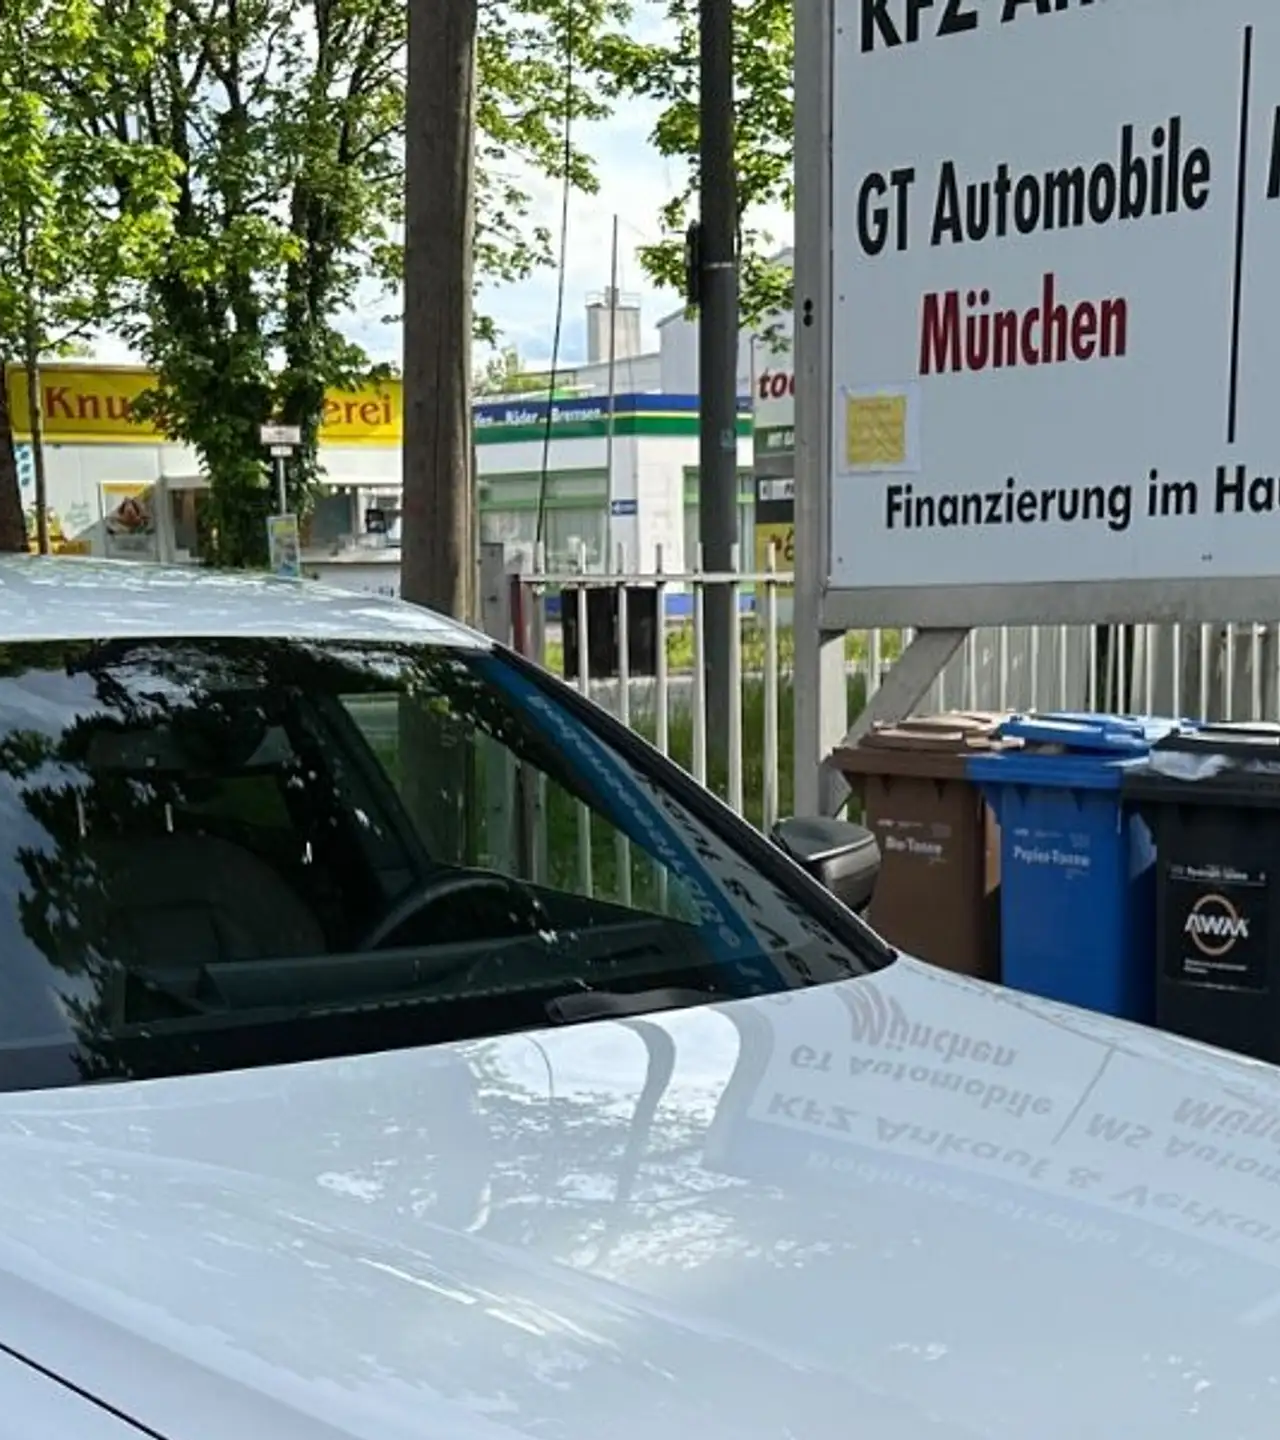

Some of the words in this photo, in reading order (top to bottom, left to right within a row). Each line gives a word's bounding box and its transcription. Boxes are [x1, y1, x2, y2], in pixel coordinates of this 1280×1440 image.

[857, 167, 915, 255] GT
[931, 116, 1210, 246] Automobile
[920, 272, 1128, 375] München
[886, 477, 1132, 531] Finanzierung
[1148, 468, 1197, 516] im
